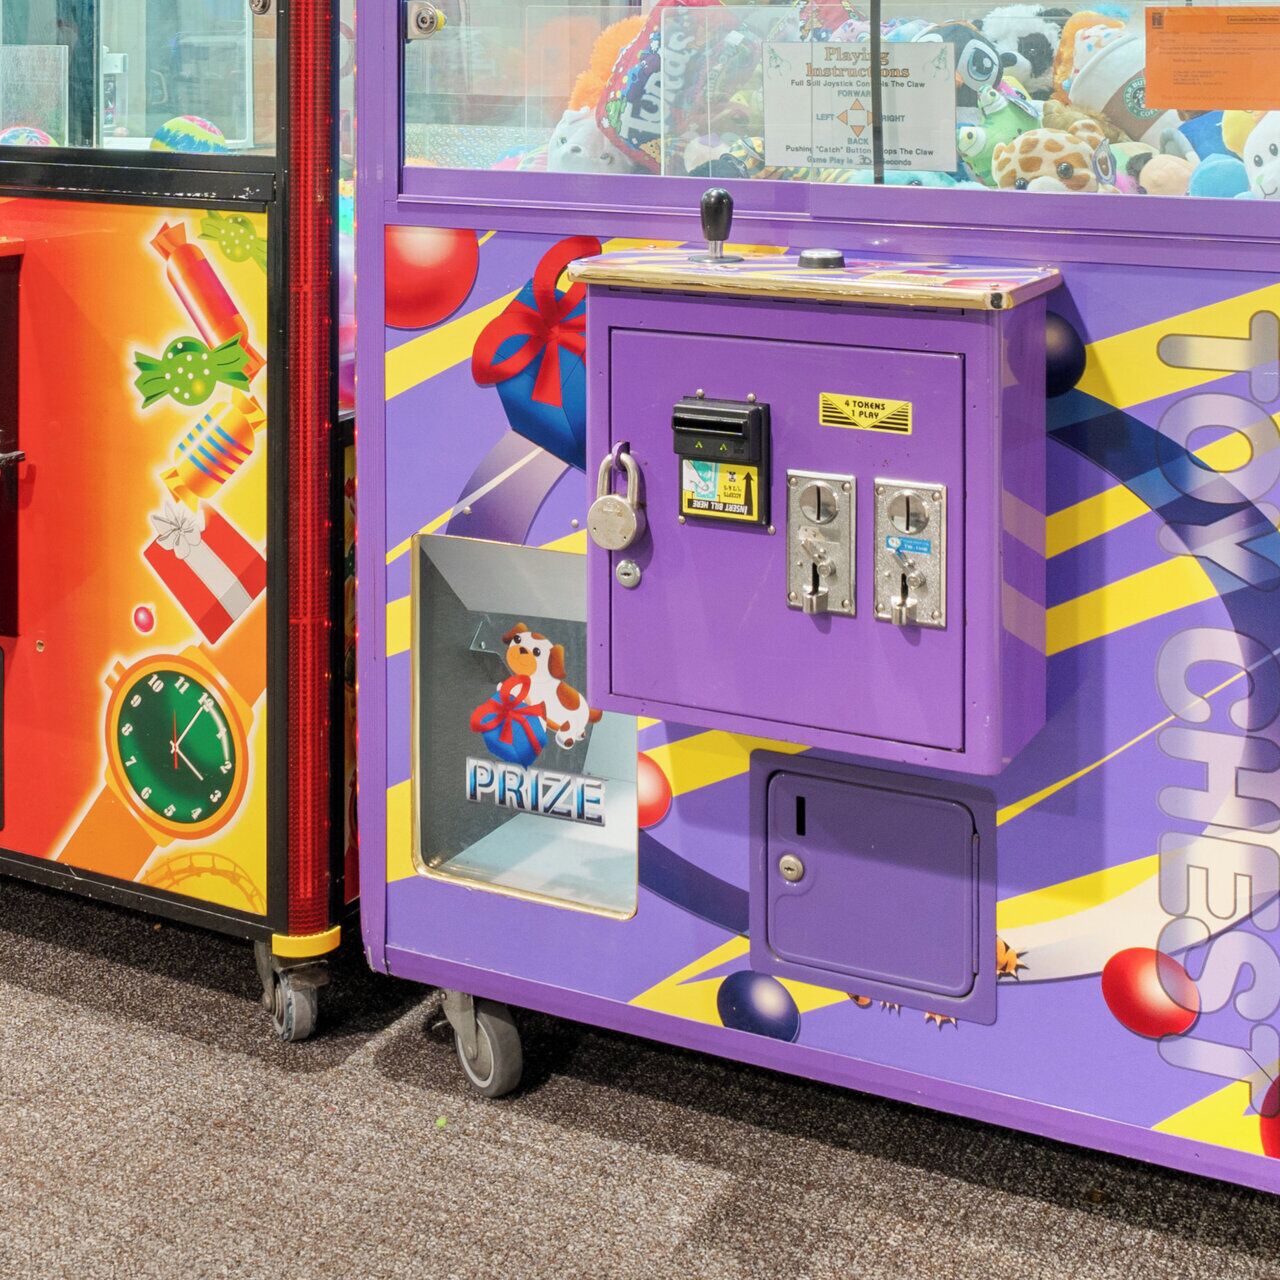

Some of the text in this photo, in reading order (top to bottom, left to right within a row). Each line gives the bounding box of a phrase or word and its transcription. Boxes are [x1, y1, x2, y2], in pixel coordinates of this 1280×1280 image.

[825, 46, 890, 66] Playig
[806, 63, 910, 78] Instrucons
[790, 79, 804, 87] Full
[823, 80, 853, 88] Joystick
[837, 90, 872, 98] FORWAR
[900, 148, 914, 156] The
[830, 157, 845, 166] Play
[853, 400, 886, 411] TOKENS
[858, 410, 880, 420] PLAY
[693, 500, 748, 515] INSERT BILL HERE
[148, 674, 164, 693] 10
[174, 676, 190, 695] 11
[130, 694, 142, 708] 9
[121, 723, 133, 736] 8
[125, 755, 137, 767] 7
[220, 760, 232, 774] 2
[141, 786, 152, 800] 6
[209, 789, 222, 803] 3
[466, 756, 606, 827] PRIZE
[164, 804, 176, 817] 5
[190, 807, 203, 820] 4
